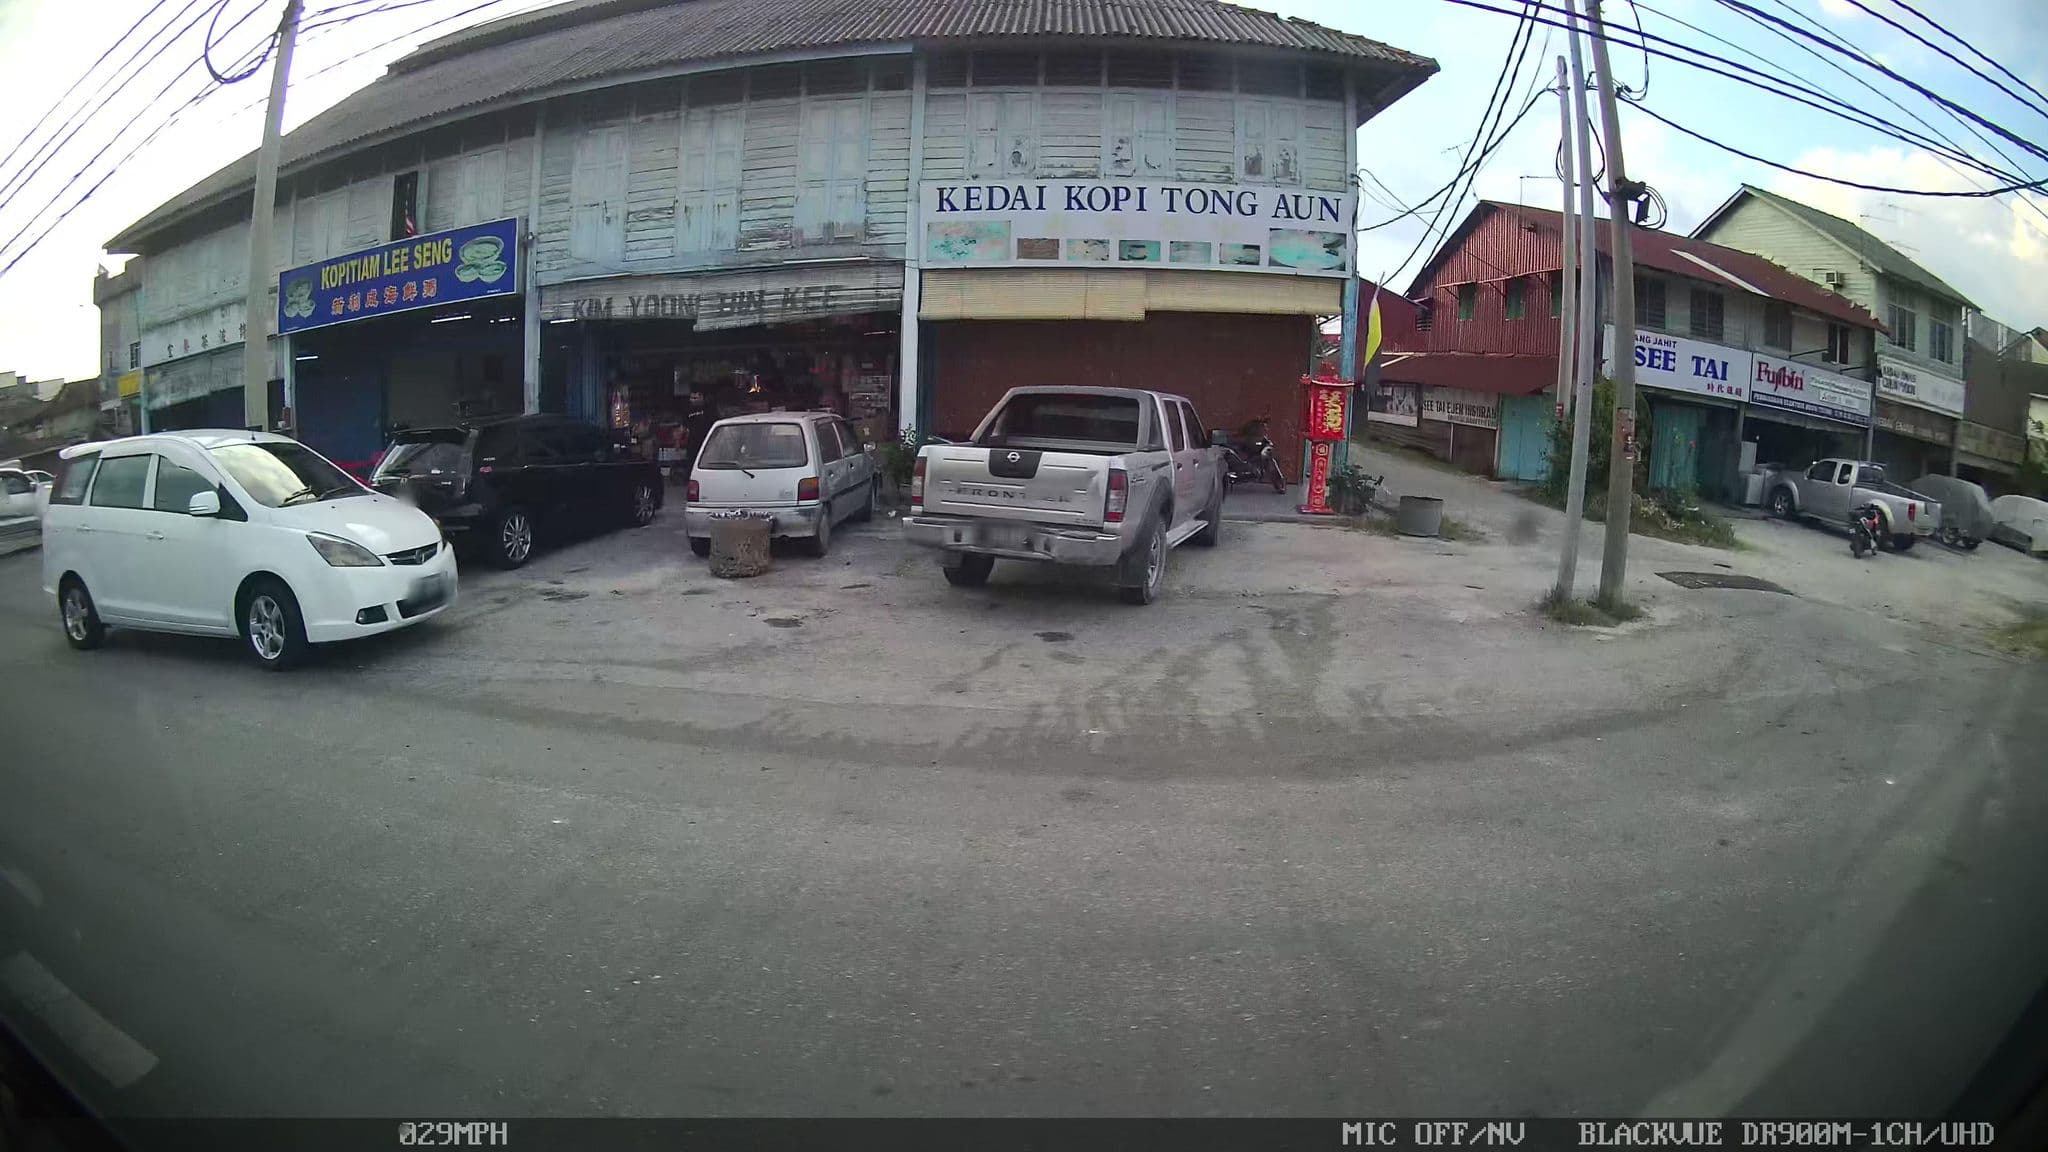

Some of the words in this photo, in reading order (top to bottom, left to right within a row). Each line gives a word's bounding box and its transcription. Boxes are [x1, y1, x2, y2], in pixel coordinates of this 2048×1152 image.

[935, 185, 1047, 212] KEDAI
[1064, 185, 1147, 212] KOPI
[1161, 187, 1258, 216] TONG
[1271, 193, 1341, 222] AUN
[321, 254, 380, 290] KOPITIAM
[383, 247, 409, 276] LEE
[413, 239, 452, 269] SENG
[1653, 338, 1677, 348] JAHIT
[1635, 345, 1676, 372] SEE
[1691, 355, 1729, 381] TAI
